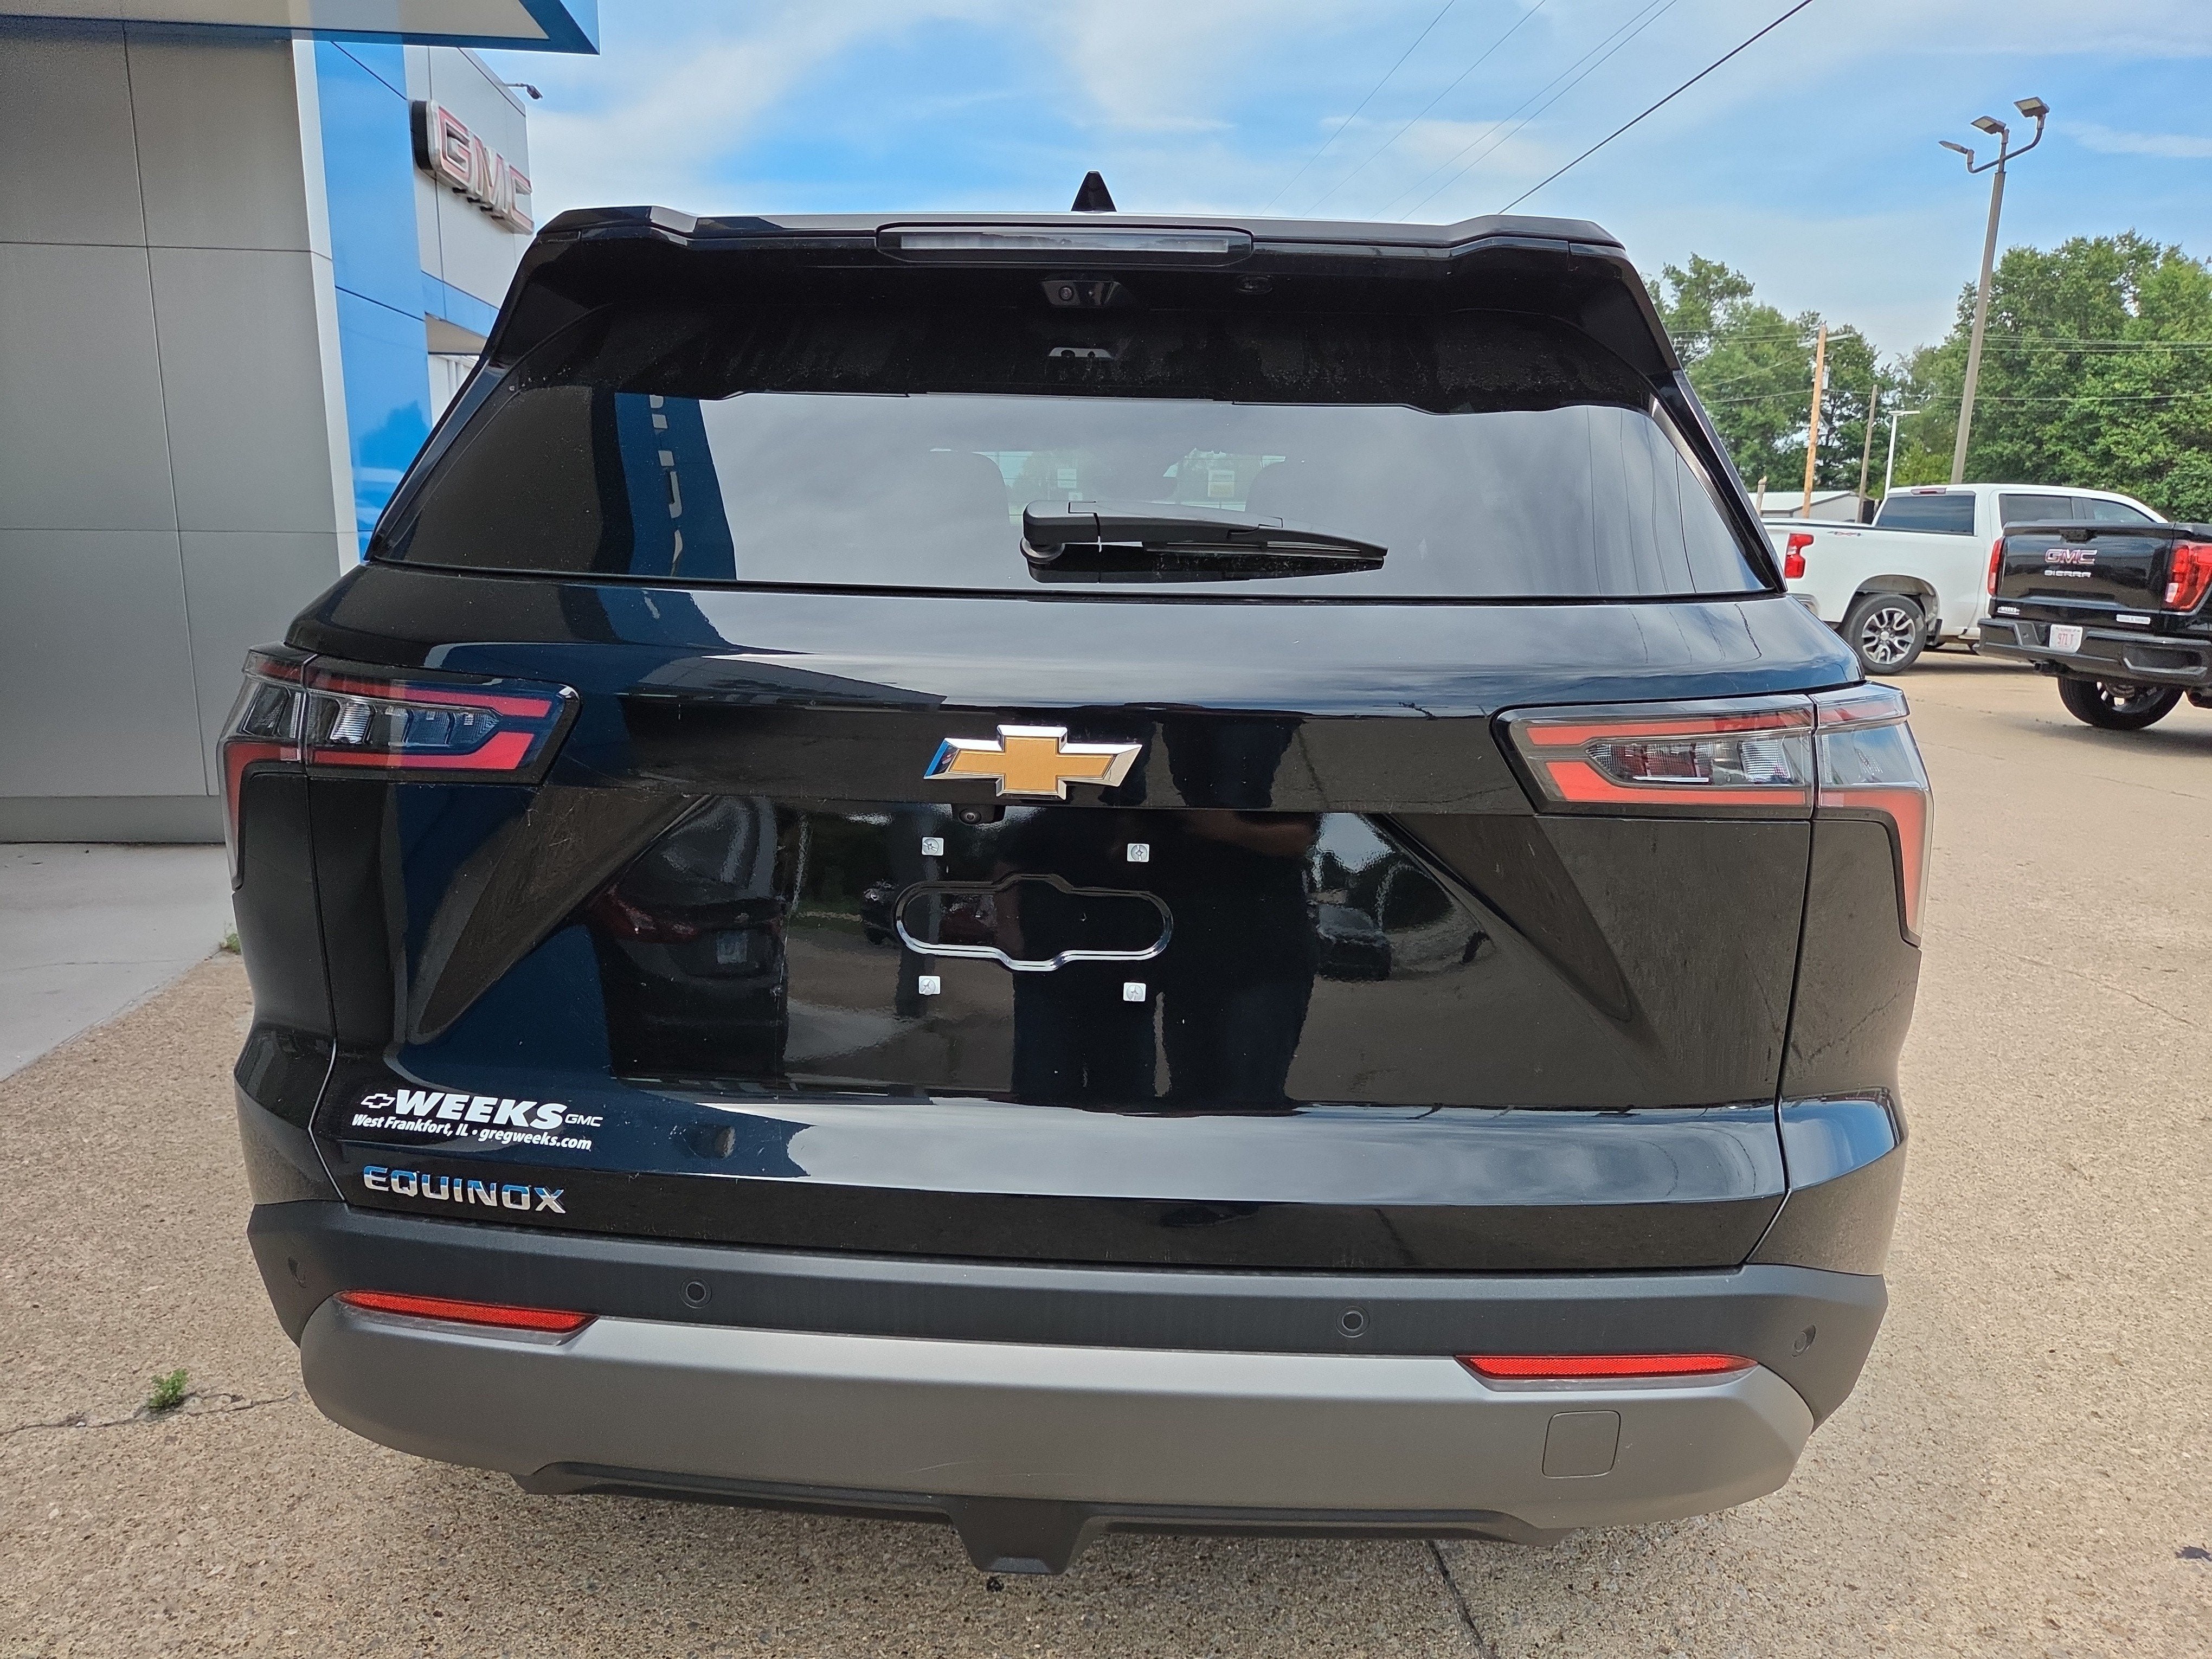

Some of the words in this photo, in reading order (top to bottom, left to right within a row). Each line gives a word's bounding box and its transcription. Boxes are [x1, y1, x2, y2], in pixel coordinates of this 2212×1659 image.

[429, 102, 535, 233] GMC
[2044, 548, 2098, 565] GMC
[2044, 570, 2092, 578] SIERRA
[395, 1089, 568, 1130] WEEKS
[564, 1113, 603, 1127] GMC
[352, 1114, 385, 1128] West
[384, 1116, 453, 1136] Frankfort,
[455, 1123, 469, 1137] IL
[478, 1128, 592, 1150] gregweeks.com
[363, 1165, 567, 1214] EQUINOX
